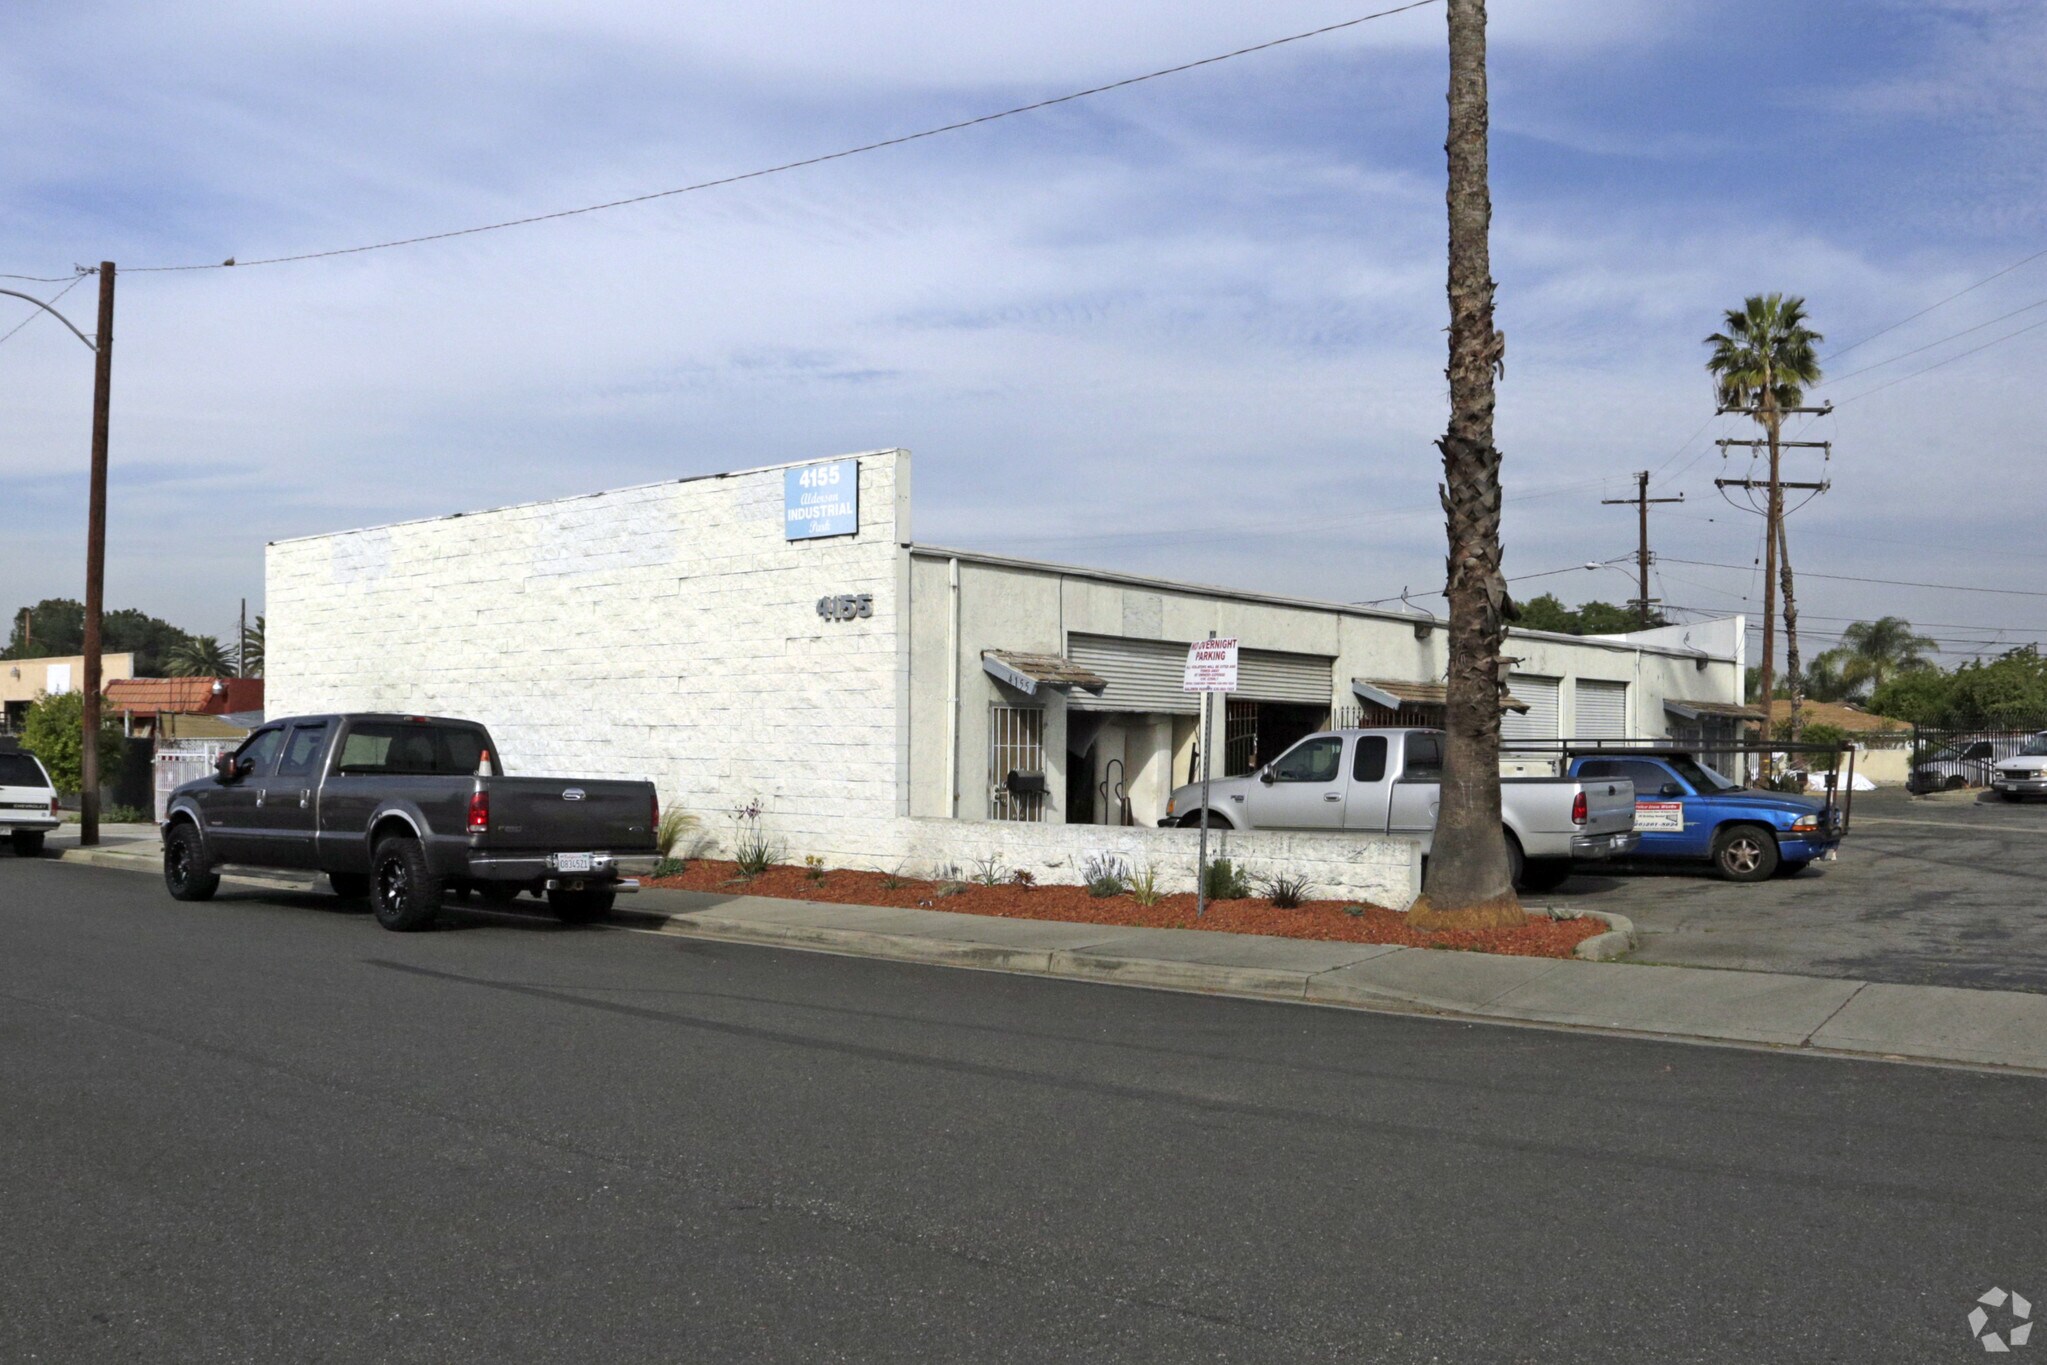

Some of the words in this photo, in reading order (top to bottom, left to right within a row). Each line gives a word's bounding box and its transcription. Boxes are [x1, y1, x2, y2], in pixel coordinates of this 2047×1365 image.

[799, 465, 840, 488] 4155
[787, 502, 853, 521] INDUSTRIAL
[808, 519, 831, 534] Park
[816, 593, 873, 622] 4155
[1199, 639, 1238, 650] OVERNIGHT
[1195, 651, 1226, 660] PARKING
